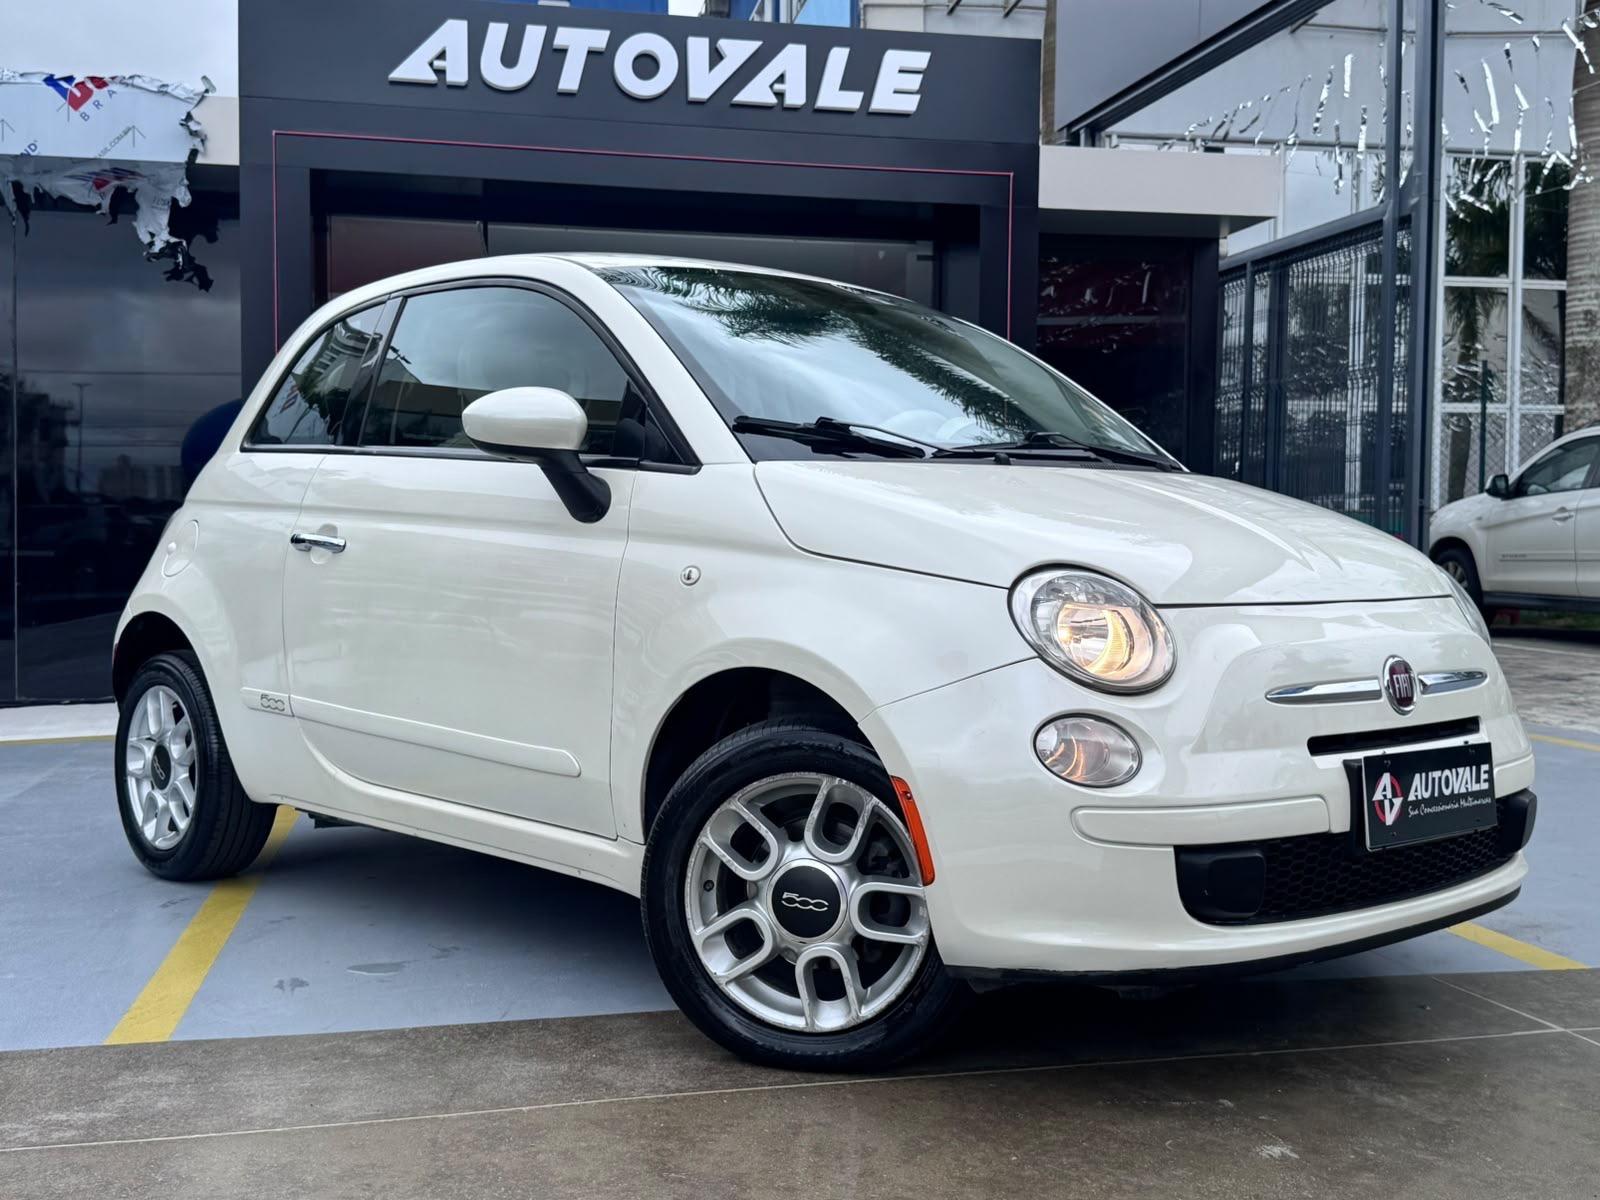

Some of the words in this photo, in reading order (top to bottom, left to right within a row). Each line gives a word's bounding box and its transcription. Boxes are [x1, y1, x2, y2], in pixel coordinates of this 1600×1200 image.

[388, 18, 932, 114] AUTOVALE
[260, 693, 285, 712] 500
[1407, 763, 1490, 802] AUTOVALE
[781, 891, 829, 912] 500
